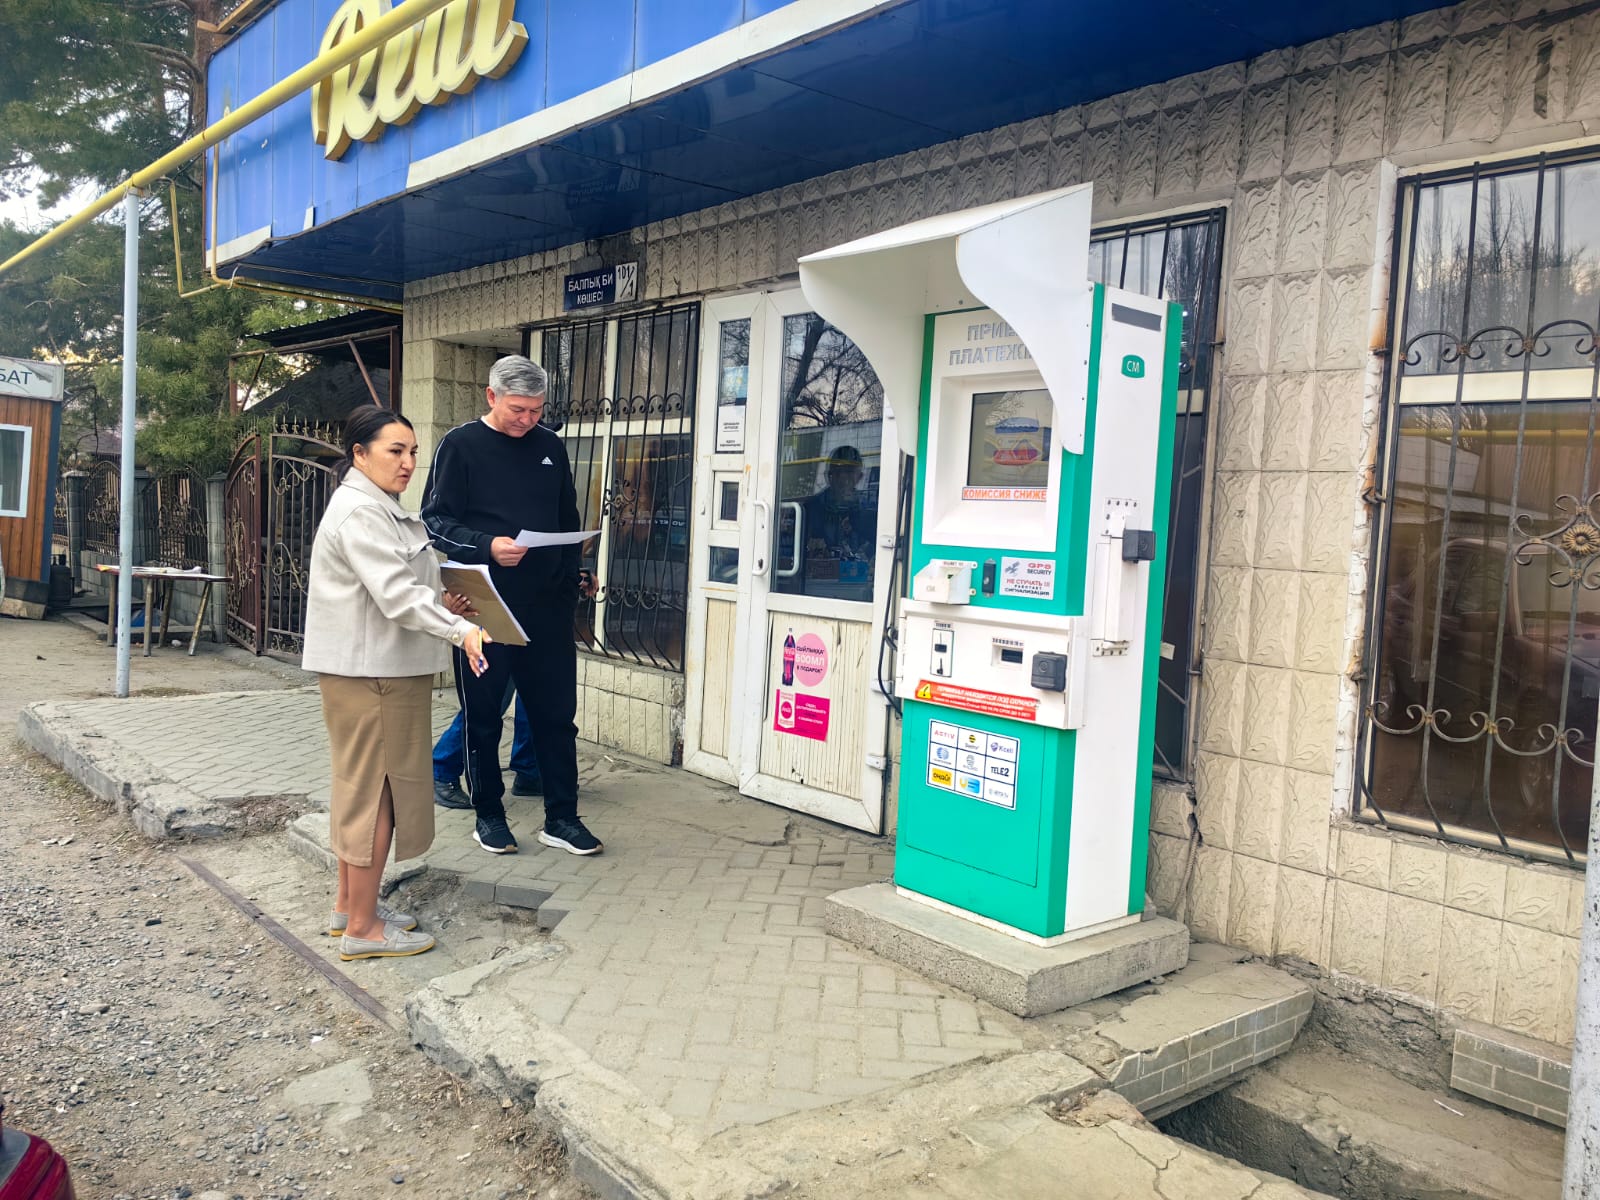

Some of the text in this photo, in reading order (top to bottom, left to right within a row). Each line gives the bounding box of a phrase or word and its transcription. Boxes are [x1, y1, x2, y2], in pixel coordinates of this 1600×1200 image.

[602, 273, 613, 286] БИ
[963, 489, 1011, 499] КОМИССИЯ
[1027, 568, 1052, 576] SECURITY
[990, 766, 1010, 777] TELE2
